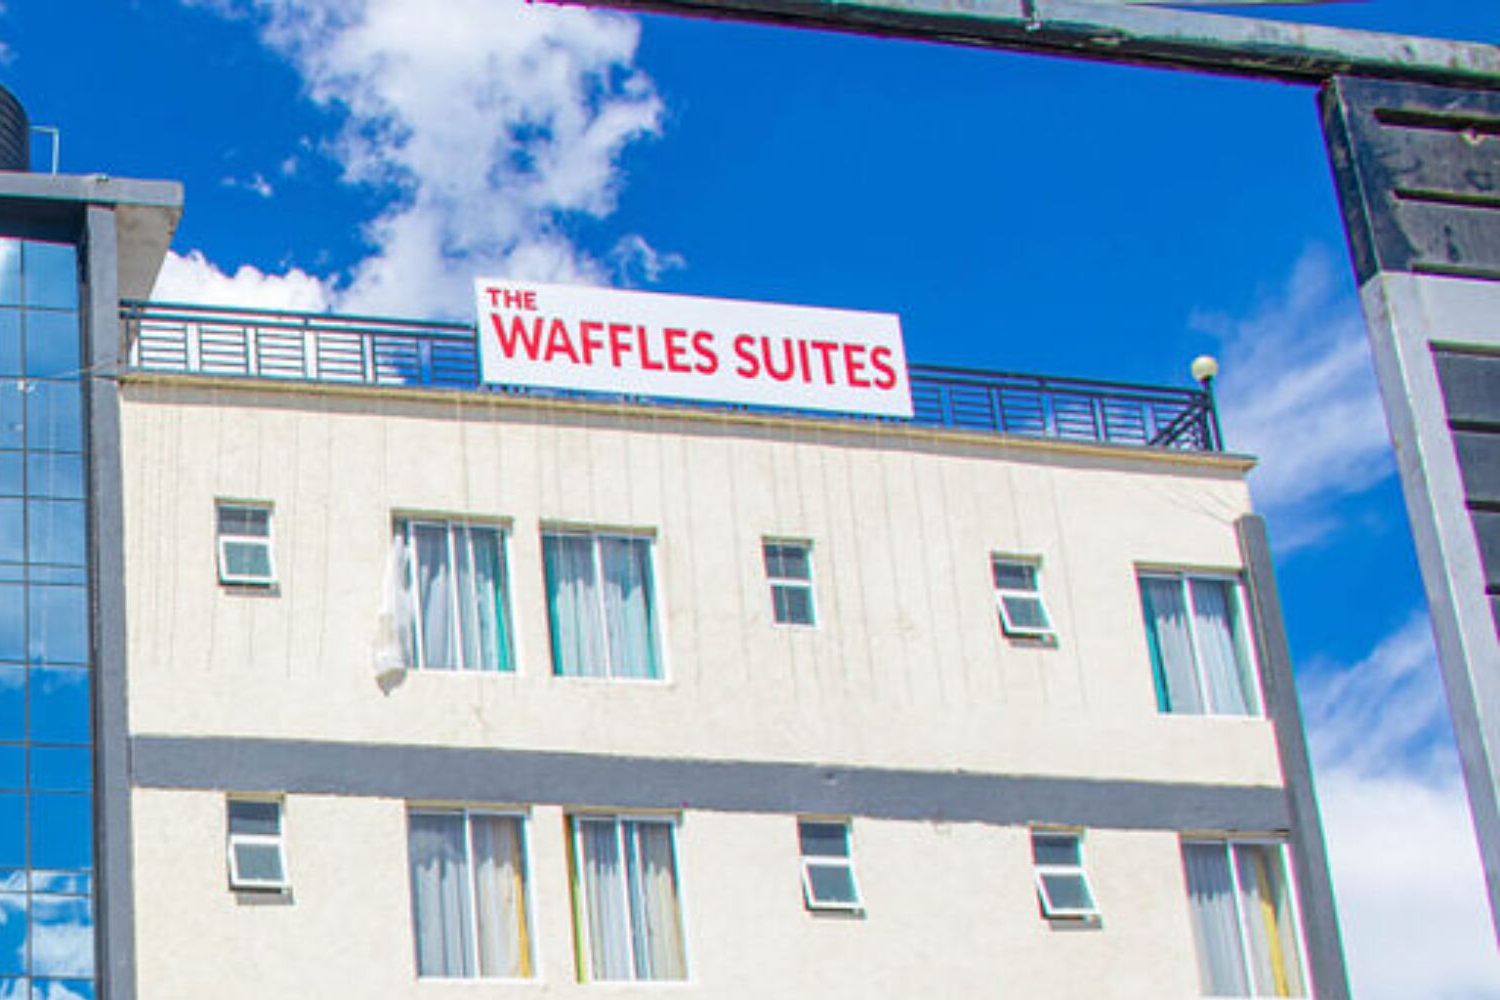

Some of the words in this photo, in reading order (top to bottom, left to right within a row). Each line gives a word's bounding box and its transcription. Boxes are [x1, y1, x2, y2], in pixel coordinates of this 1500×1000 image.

[485, 287, 538, 311] THE
[491, 313, 719, 375] WAFFLES
[733, 333, 897, 390] SUITES
